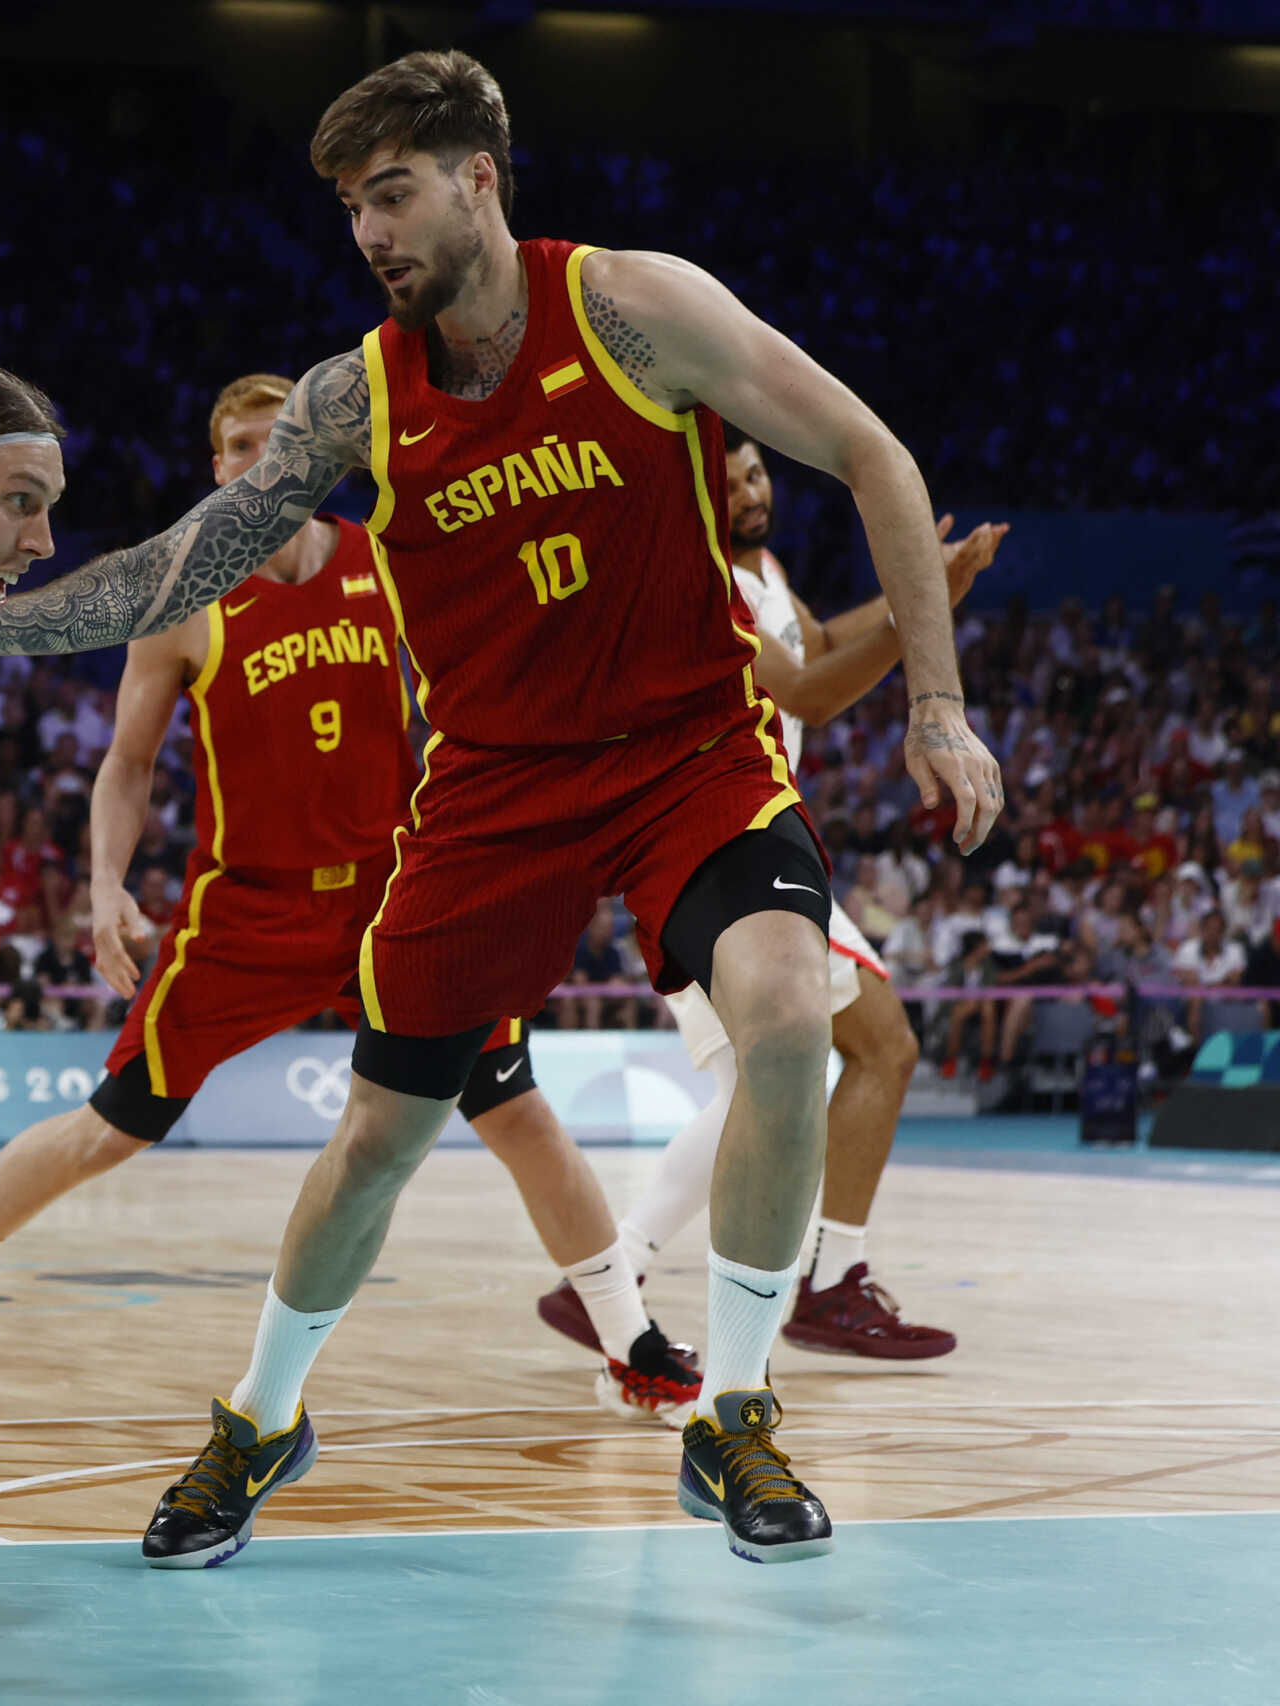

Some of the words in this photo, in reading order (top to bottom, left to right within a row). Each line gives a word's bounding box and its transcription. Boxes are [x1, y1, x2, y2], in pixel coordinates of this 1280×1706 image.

[424, 434, 624, 533] ESPAÑA
[517, 532, 590, 605] 10
[242, 618, 389, 696] ESPAÑA
[309, 699, 342, 752] 9
